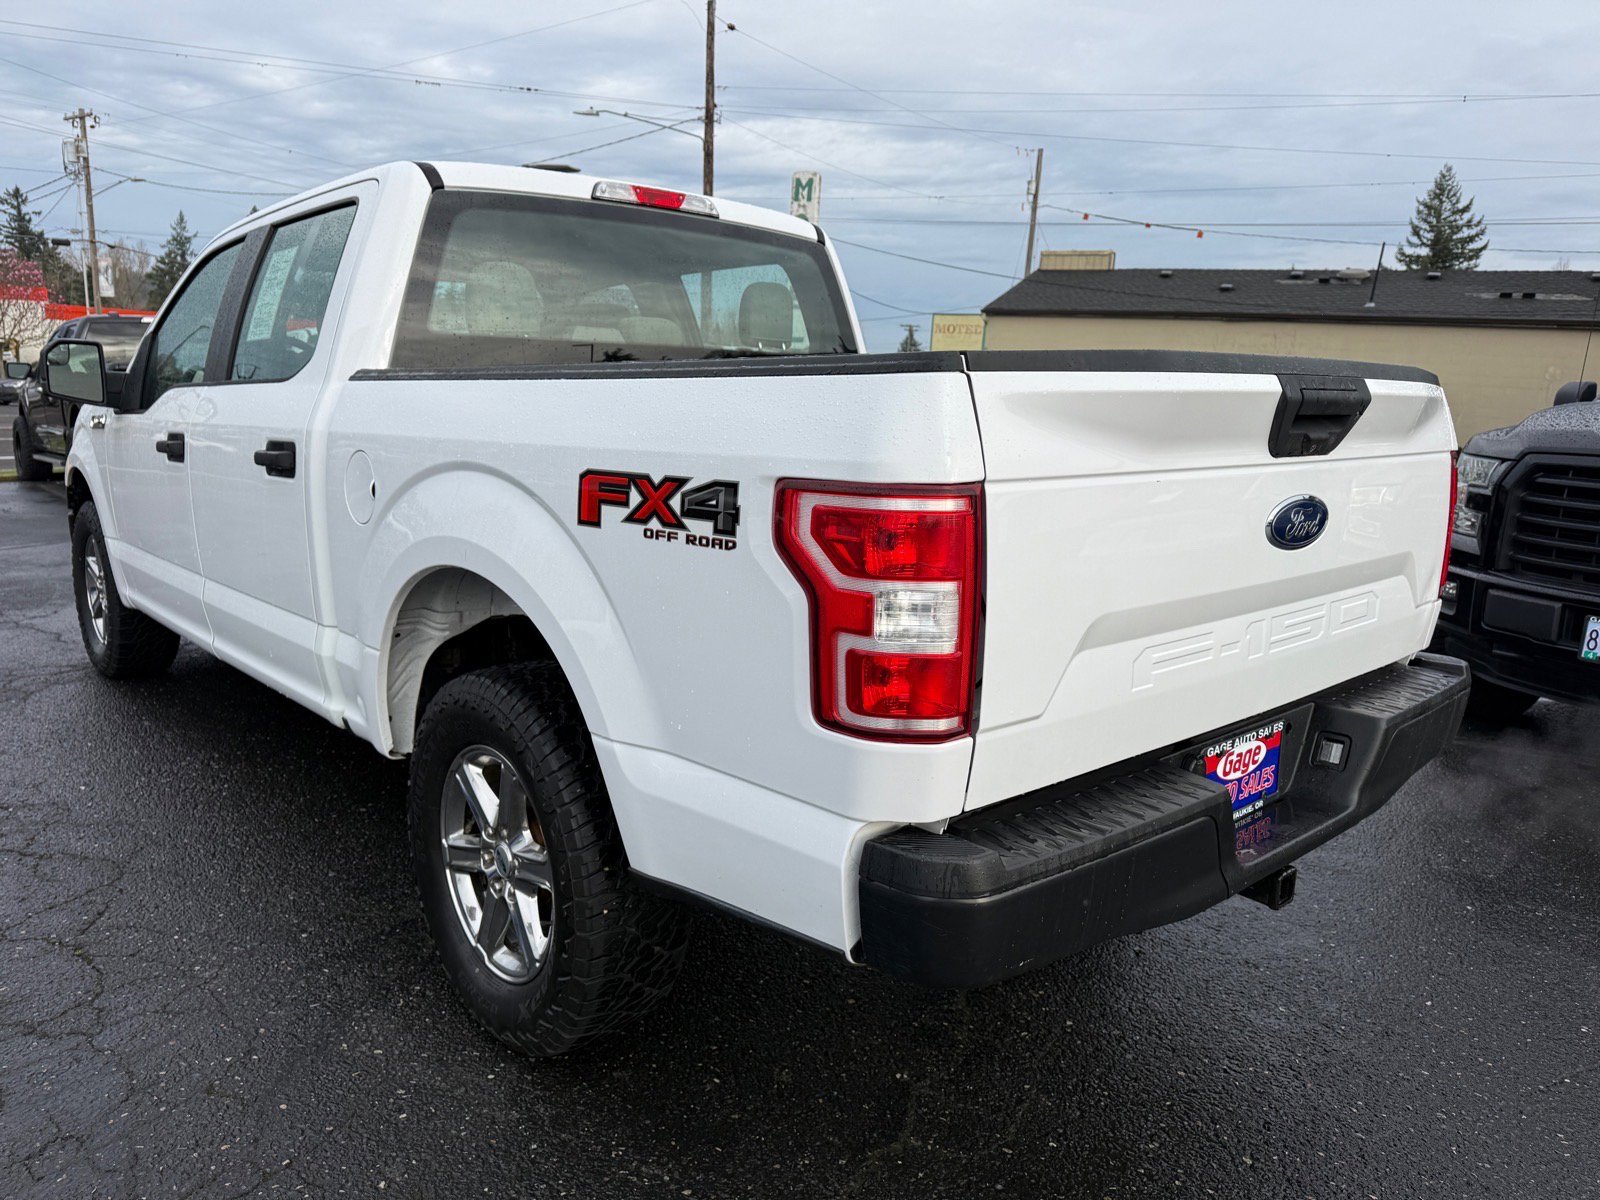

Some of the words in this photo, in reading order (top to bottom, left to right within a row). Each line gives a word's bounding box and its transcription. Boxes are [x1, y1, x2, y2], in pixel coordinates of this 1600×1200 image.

[934, 322, 982, 335] MOTEL
[577, 468, 741, 538] FX4
[643, 527, 679, 543] OFF
[685, 532, 737, 551] ROAD
[1285, 507, 1321, 540] Ford
[1132, 590, 1380, 692] F-150
[1207, 740, 1233, 758] GAGE
[1234, 732, 1257, 748] AUTO
[1258, 721, 1284, 739] SALES
[1222, 744, 1262, 778] Gage
[1238, 764, 1276, 800] SALES
[1254, 800, 1264, 809] OR
